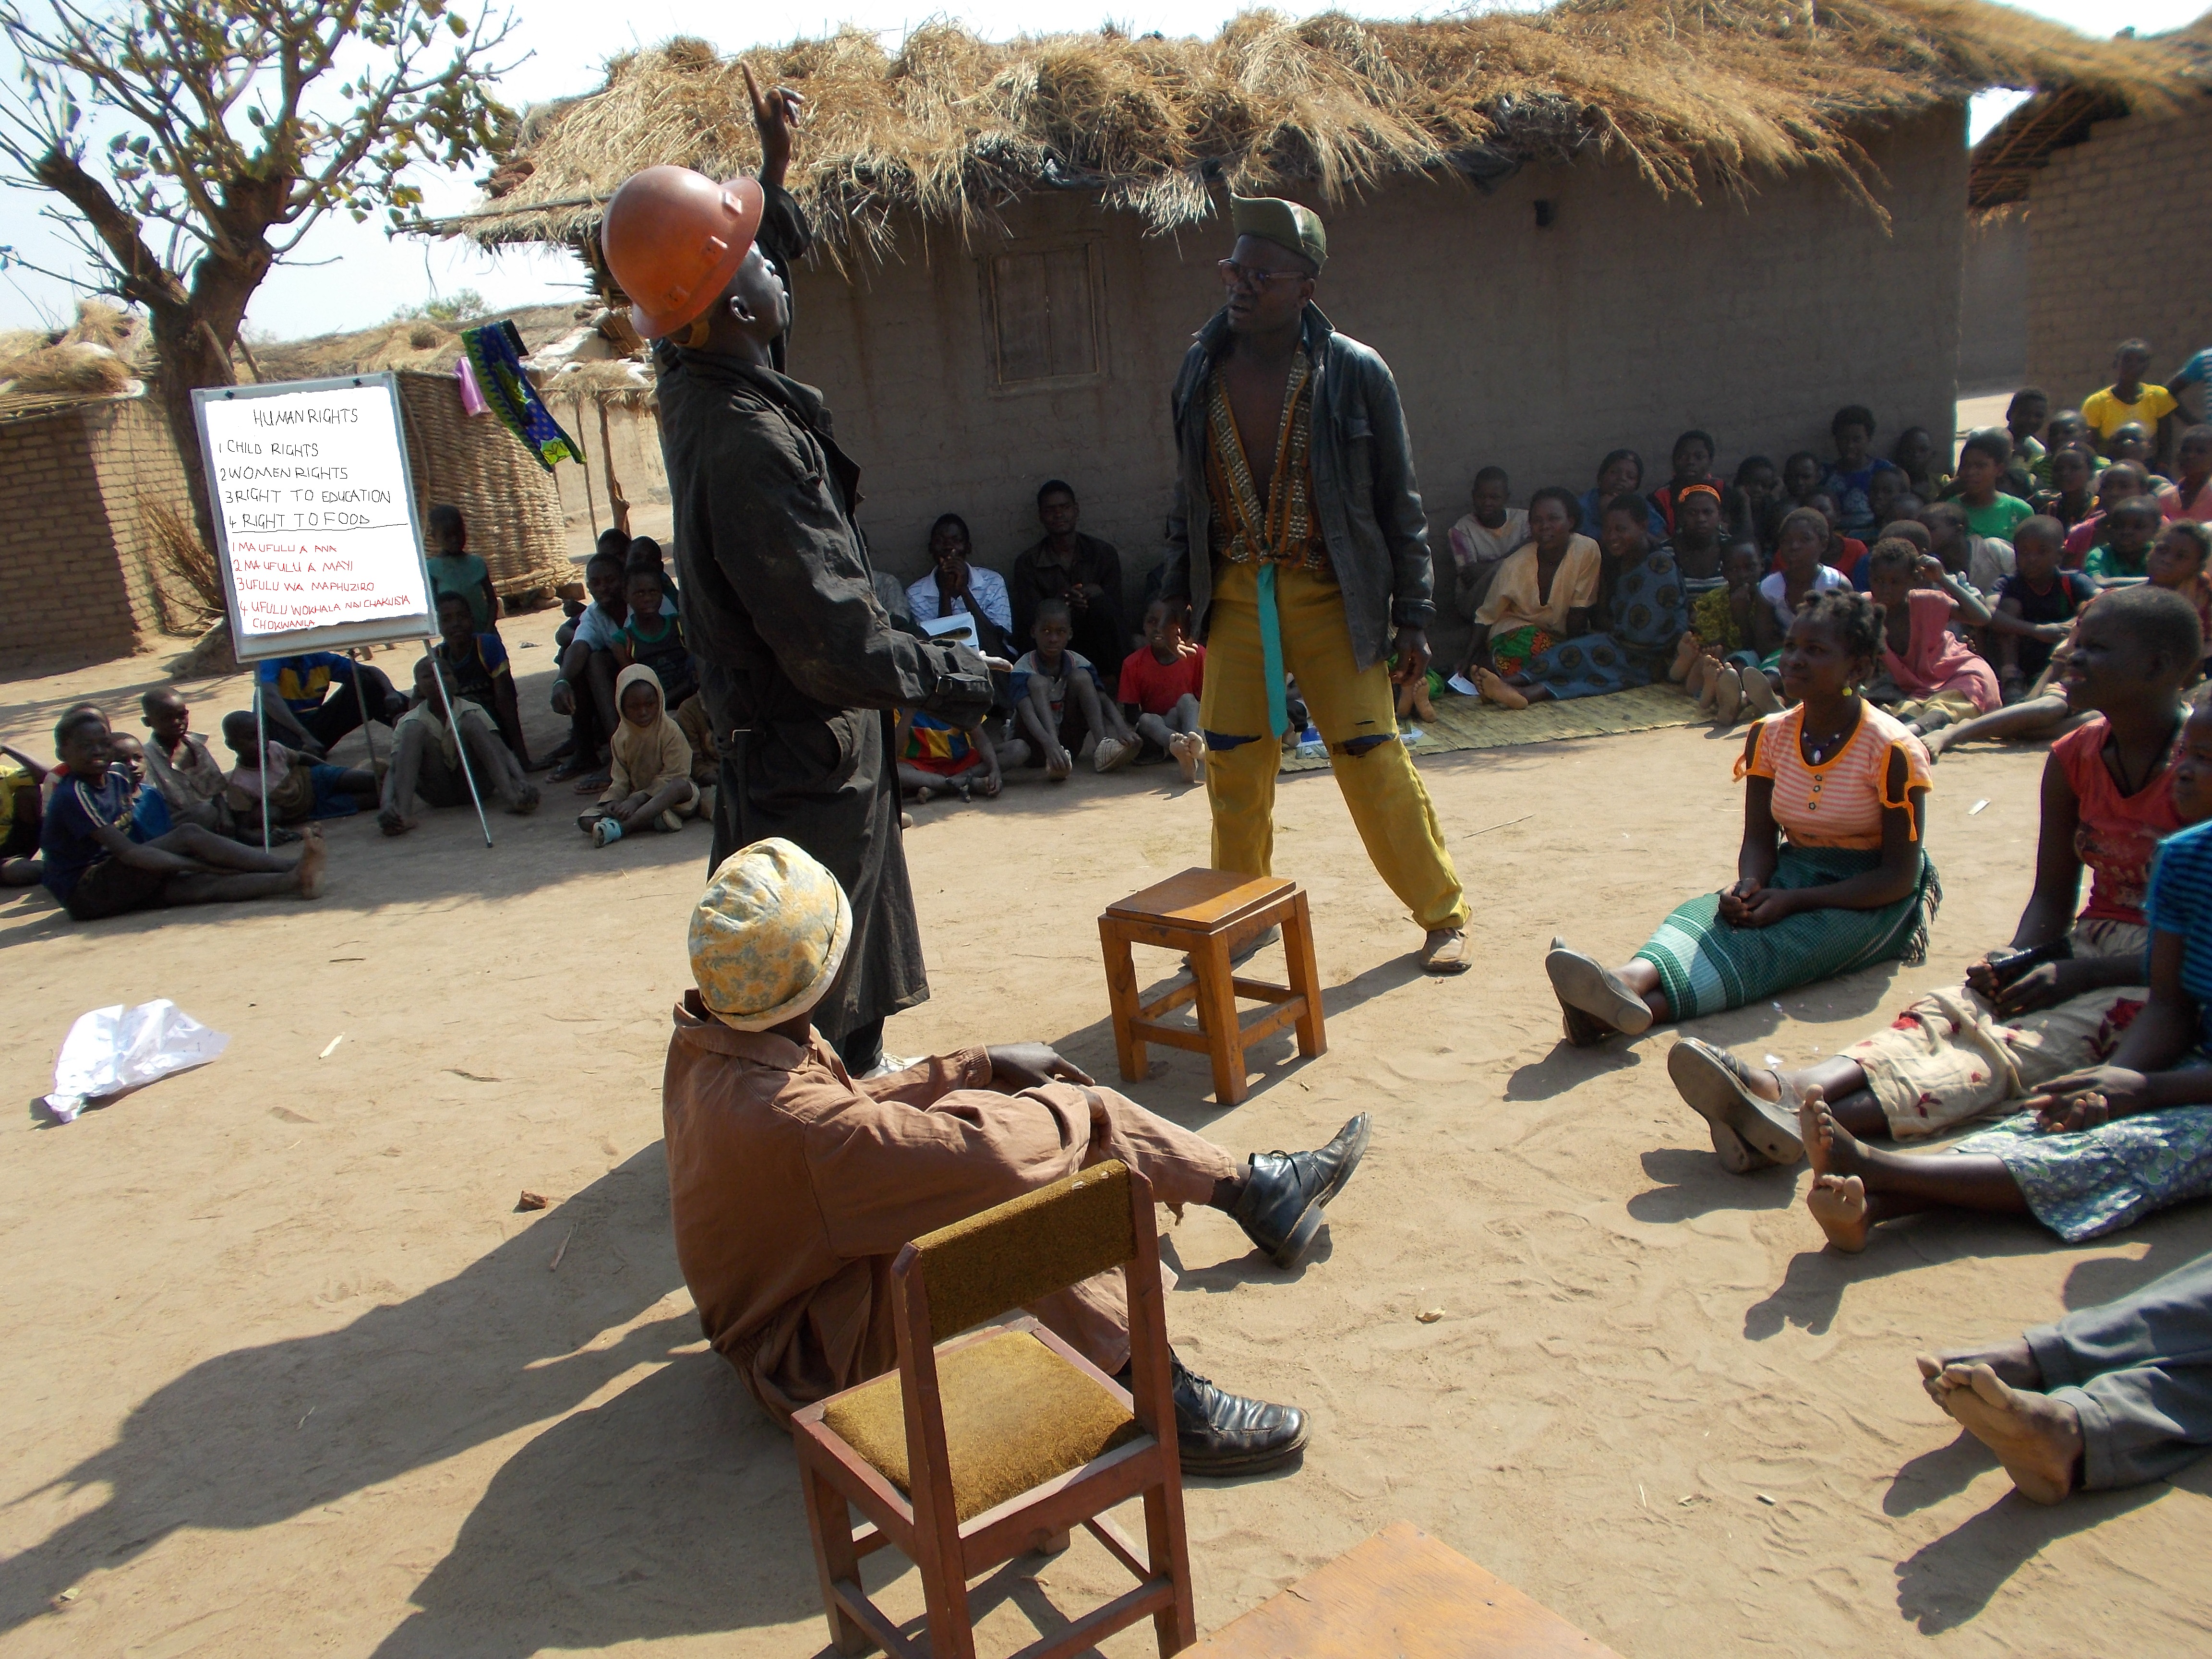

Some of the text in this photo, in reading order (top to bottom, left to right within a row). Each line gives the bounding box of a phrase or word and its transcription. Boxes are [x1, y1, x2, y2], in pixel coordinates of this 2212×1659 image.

[253, 409, 358, 427] HUMAN RIGHTS
[228, 440, 262, 454] CHILD
[271, 443, 318, 457] RIGHTS
[295, 467, 348, 480] RIGHTS
[290, 489, 313, 502] TO
[322, 489, 390, 504] EDUCATION
[229, 512, 370, 529] 4 RIGHT TO FOOD
[299, 545, 308, 554] A
[308, 563, 316, 572] A
[323, 560, 352, 572] MAYI
[284, 582, 304, 591] WA
[312, 582, 374, 591] MAPHUZIRO
[240, 601, 248, 616] 4
[252, 601, 287, 614] UFULU
[291, 603, 341, 616] WOKHALA
[253, 618, 315, 631] CHOKWANILA
